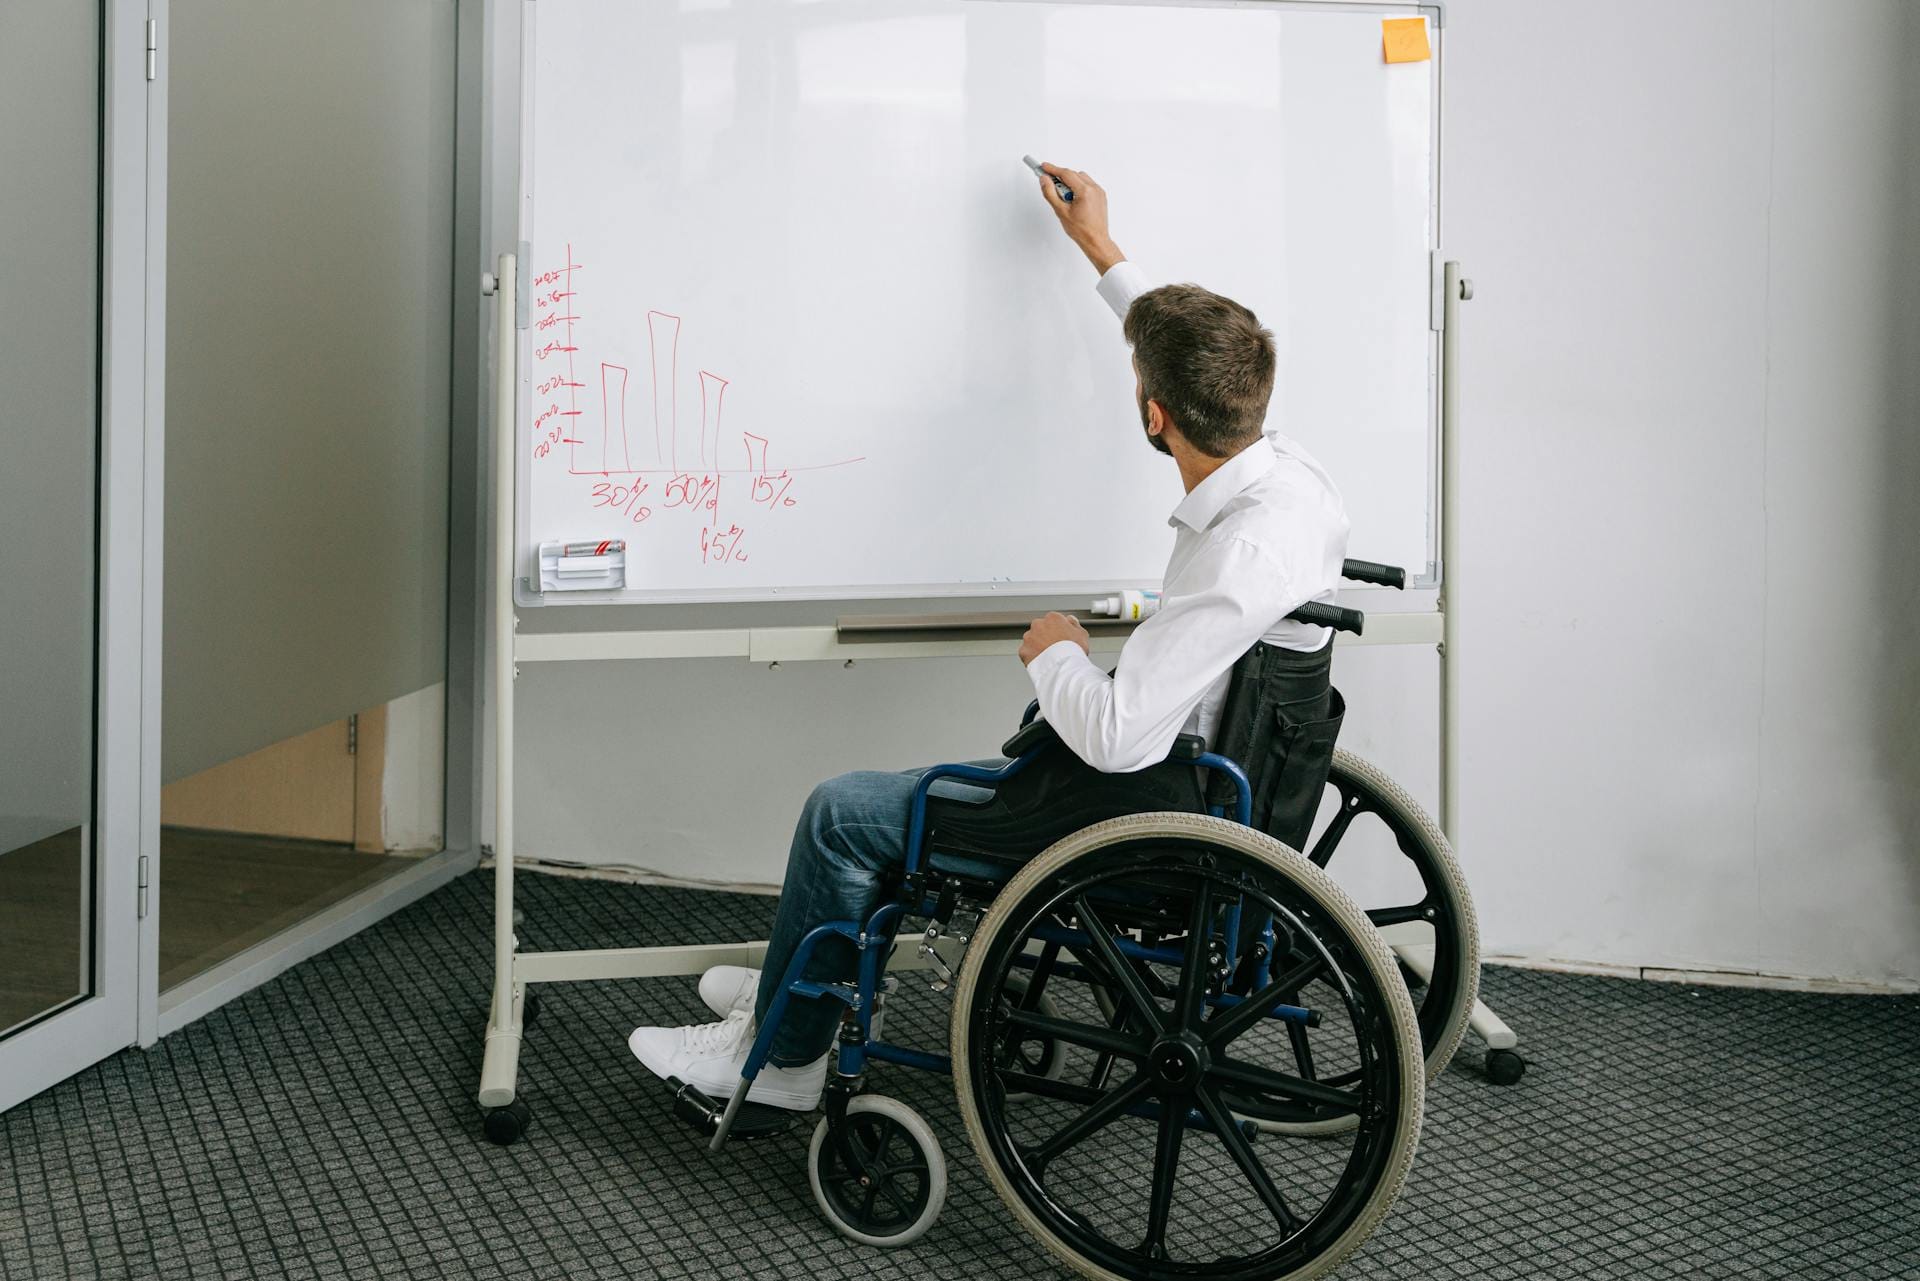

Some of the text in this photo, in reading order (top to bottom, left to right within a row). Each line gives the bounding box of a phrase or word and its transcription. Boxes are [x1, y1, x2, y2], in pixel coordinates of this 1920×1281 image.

[591, 470, 797, 523] 30% 50% 15%
